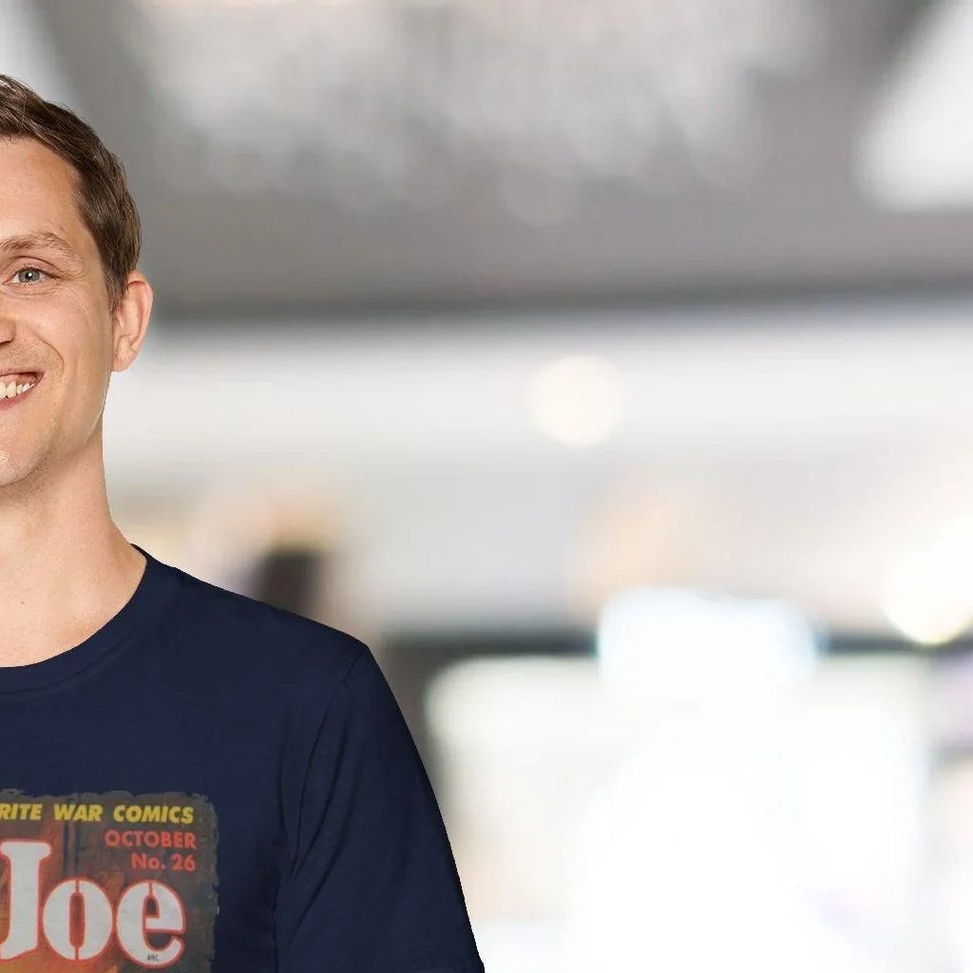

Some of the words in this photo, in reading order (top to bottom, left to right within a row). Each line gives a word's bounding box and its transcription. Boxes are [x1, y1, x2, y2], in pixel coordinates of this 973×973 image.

[53, 804, 103, 822] WAR
[113, 805, 194, 824] COMICS
[104, 829, 196, 848] OCTOBER
[131, 852, 165, 870] No.
[171, 853, 195, 871] 26
